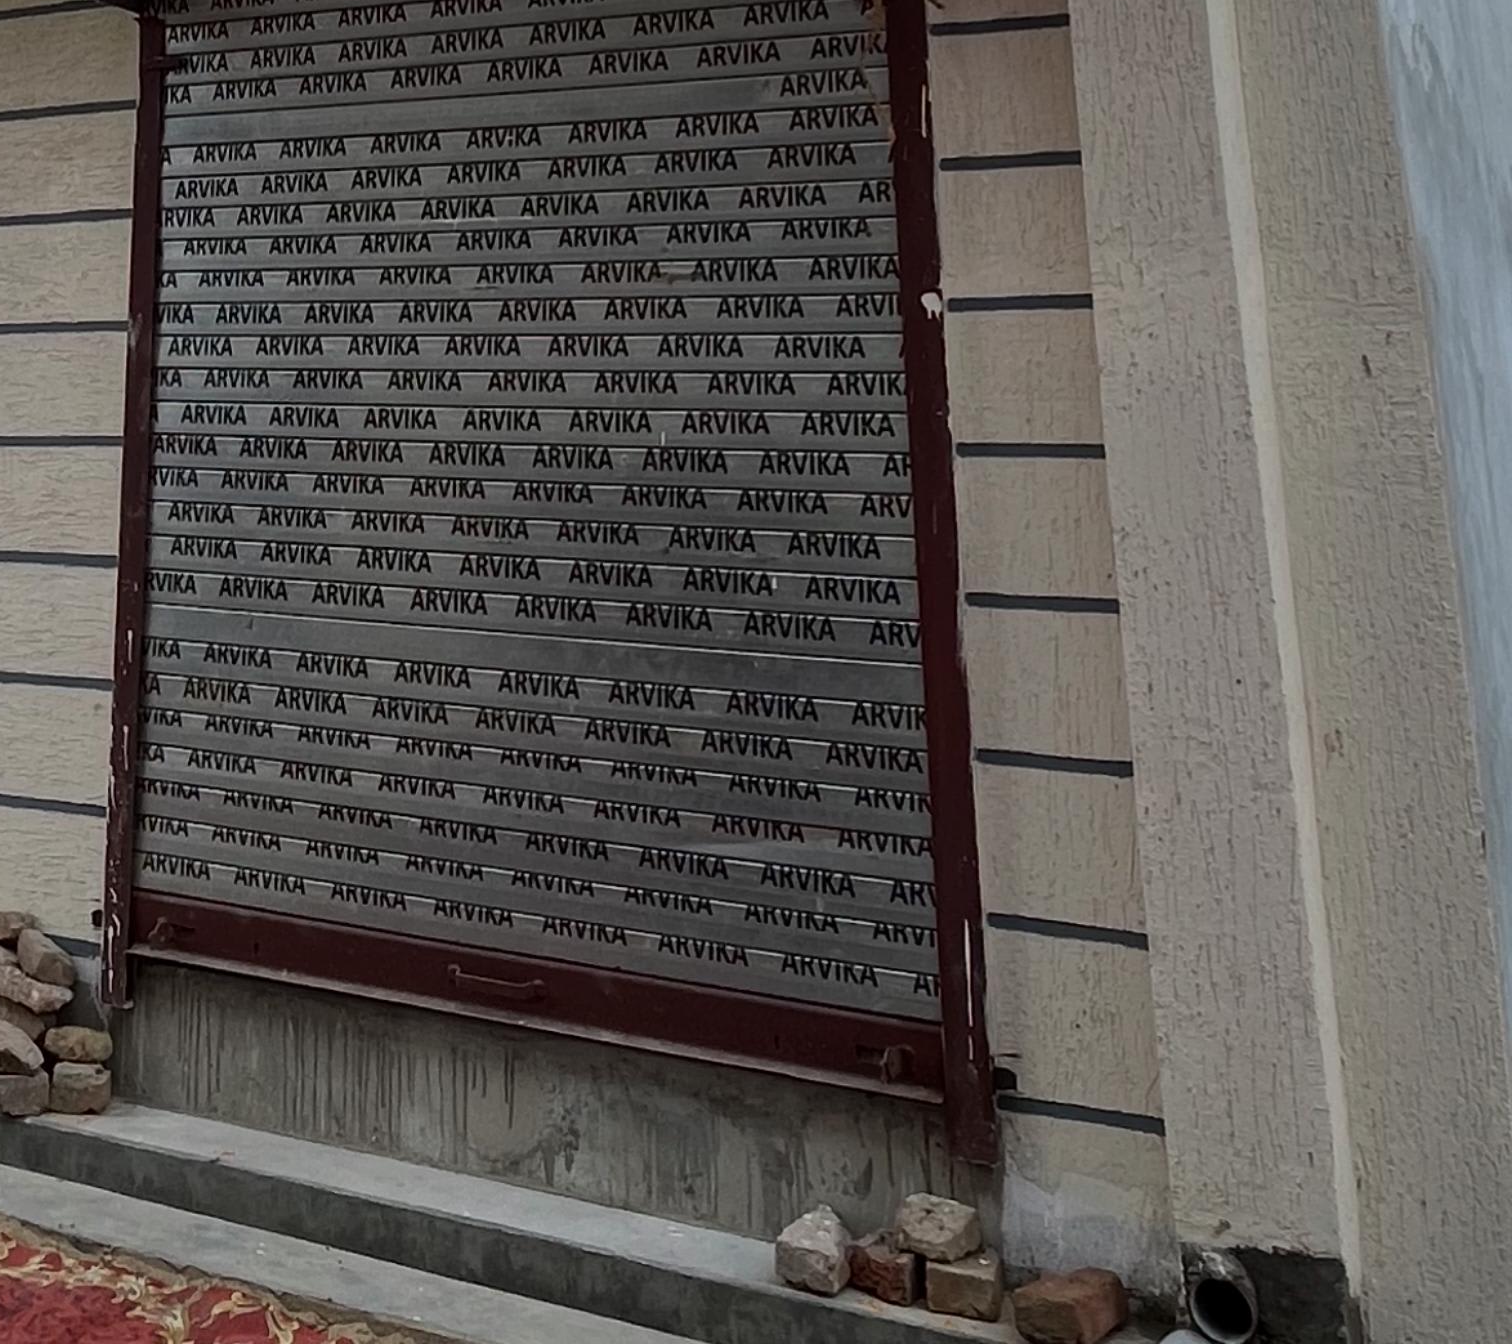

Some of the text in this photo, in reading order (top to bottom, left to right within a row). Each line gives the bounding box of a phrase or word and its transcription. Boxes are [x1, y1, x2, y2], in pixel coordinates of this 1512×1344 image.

[166, 18, 230, 42] ARVIKA
[250, 13, 315, 35] ARVIKA
[338, 3, 407, 27] ARVIKA
[250, 0, 829, 69] ARVIKA ARVIKA ARVIKA ARVIKA ARVIKA ARVIKA
[212, 41, 780, 101] ARVIKA ARVIKA ARVIKA ARVIKA ARVIKA ARVIKA
[779, 68, 868, 96] ARVIKA
[193, 141, 257, 163] ARVIKA
[278, 137, 346, 159] ARVIKA
[370, 131, 441, 154] ARVIKA
[567, 119, 647, 144] ARVIKA
[675, 112, 759, 138] ARVIKA
[789, 104, 878, 131] ARVIKA
[175, 143, 856, 199] ARVIKA ARVIKA ARVIKA ARVIKA ARVIKA ARVIKA ARVIKA
[236, 184, 826, 226] ARVIKA ARVIKA ARVIKA ARVIKA ARVIKA ARVIKA
[183, 217, 872, 256] ARVIKA ARVIKA ARVIKA ARVIKA ARVIKA ARVIKA ARVIKA
[198, 269, 264, 287] ARVIKA
[286, 268, 355, 286] ARVIKA
[378, 266, 451, 285] ARVIKA
[476, 264, 554, 284] ARVIKA
[689, 258, 778, 282] ARVIKA
[808, 255, 902, 280] ARVIKA
[215, 295, 804, 325] ARVIKA ARVIKA ARVIKA ARVIKA ARVIKA ARVIKA
[167, 334, 865, 359] ARVIKA ARVIKA ARVIKA ARVIKA ARVIKA ARVIKA ARVIKA
[203, 369, 270, 389] ARVIKA
[292, 370, 363, 390] ARVIKA
[386, 370, 462, 391] ARVIKA
[487, 371, 566, 393] ARVIKA
[594, 372, 677, 394] ARVIKA
[707, 373, 796, 395] ARVIKA
[180, 401, 895, 437] ARVIKA ARVIKA ARVIKA ARVIKA ARVIKA ARVIKA ARVIKA
[153, 434, 850, 476] ARVIKA ARVIKA ARVIKA ARVIKA ARVIKA ARVIKA ARVIKA
[220, 470, 828, 514] ARVIKA ARVIKA ARVIKA ARVIKA ARVIKA ARVIKA
[167, 503, 881, 559] ARVIKA ARVIKA ARVIKA ARVIKA ARVIKA ARVIKA ARVIKA
[170, 537, 900, 604] ARVIKA ARVIKA ARVIKA ARVIKA ARVIKA ARVIKA ARVIKA
[218, 576, 836, 641] ARVIKA ARVIKA ARVIKA ARVIKA ARVIKA ARVIKA
[203, 643, 818, 722] ARVIKA ARVIKA ARVIKA ARVIKA ARVIKA ARVIKA
[183, 677, 923, 773] ARVIKA ARVIKA ARVIKA ARVIKA ARVIKA ARVIKA ARVIKA
[187, 749, 804, 843] ARVIKA ARVIKA ARVIKA ARVIKA ARVIKA ARVIKA
[140, 852, 878, 987] ARVIKA ARVIKA ARVIKA ARVIKA ARVIKA ARVIKA ARVIKA
